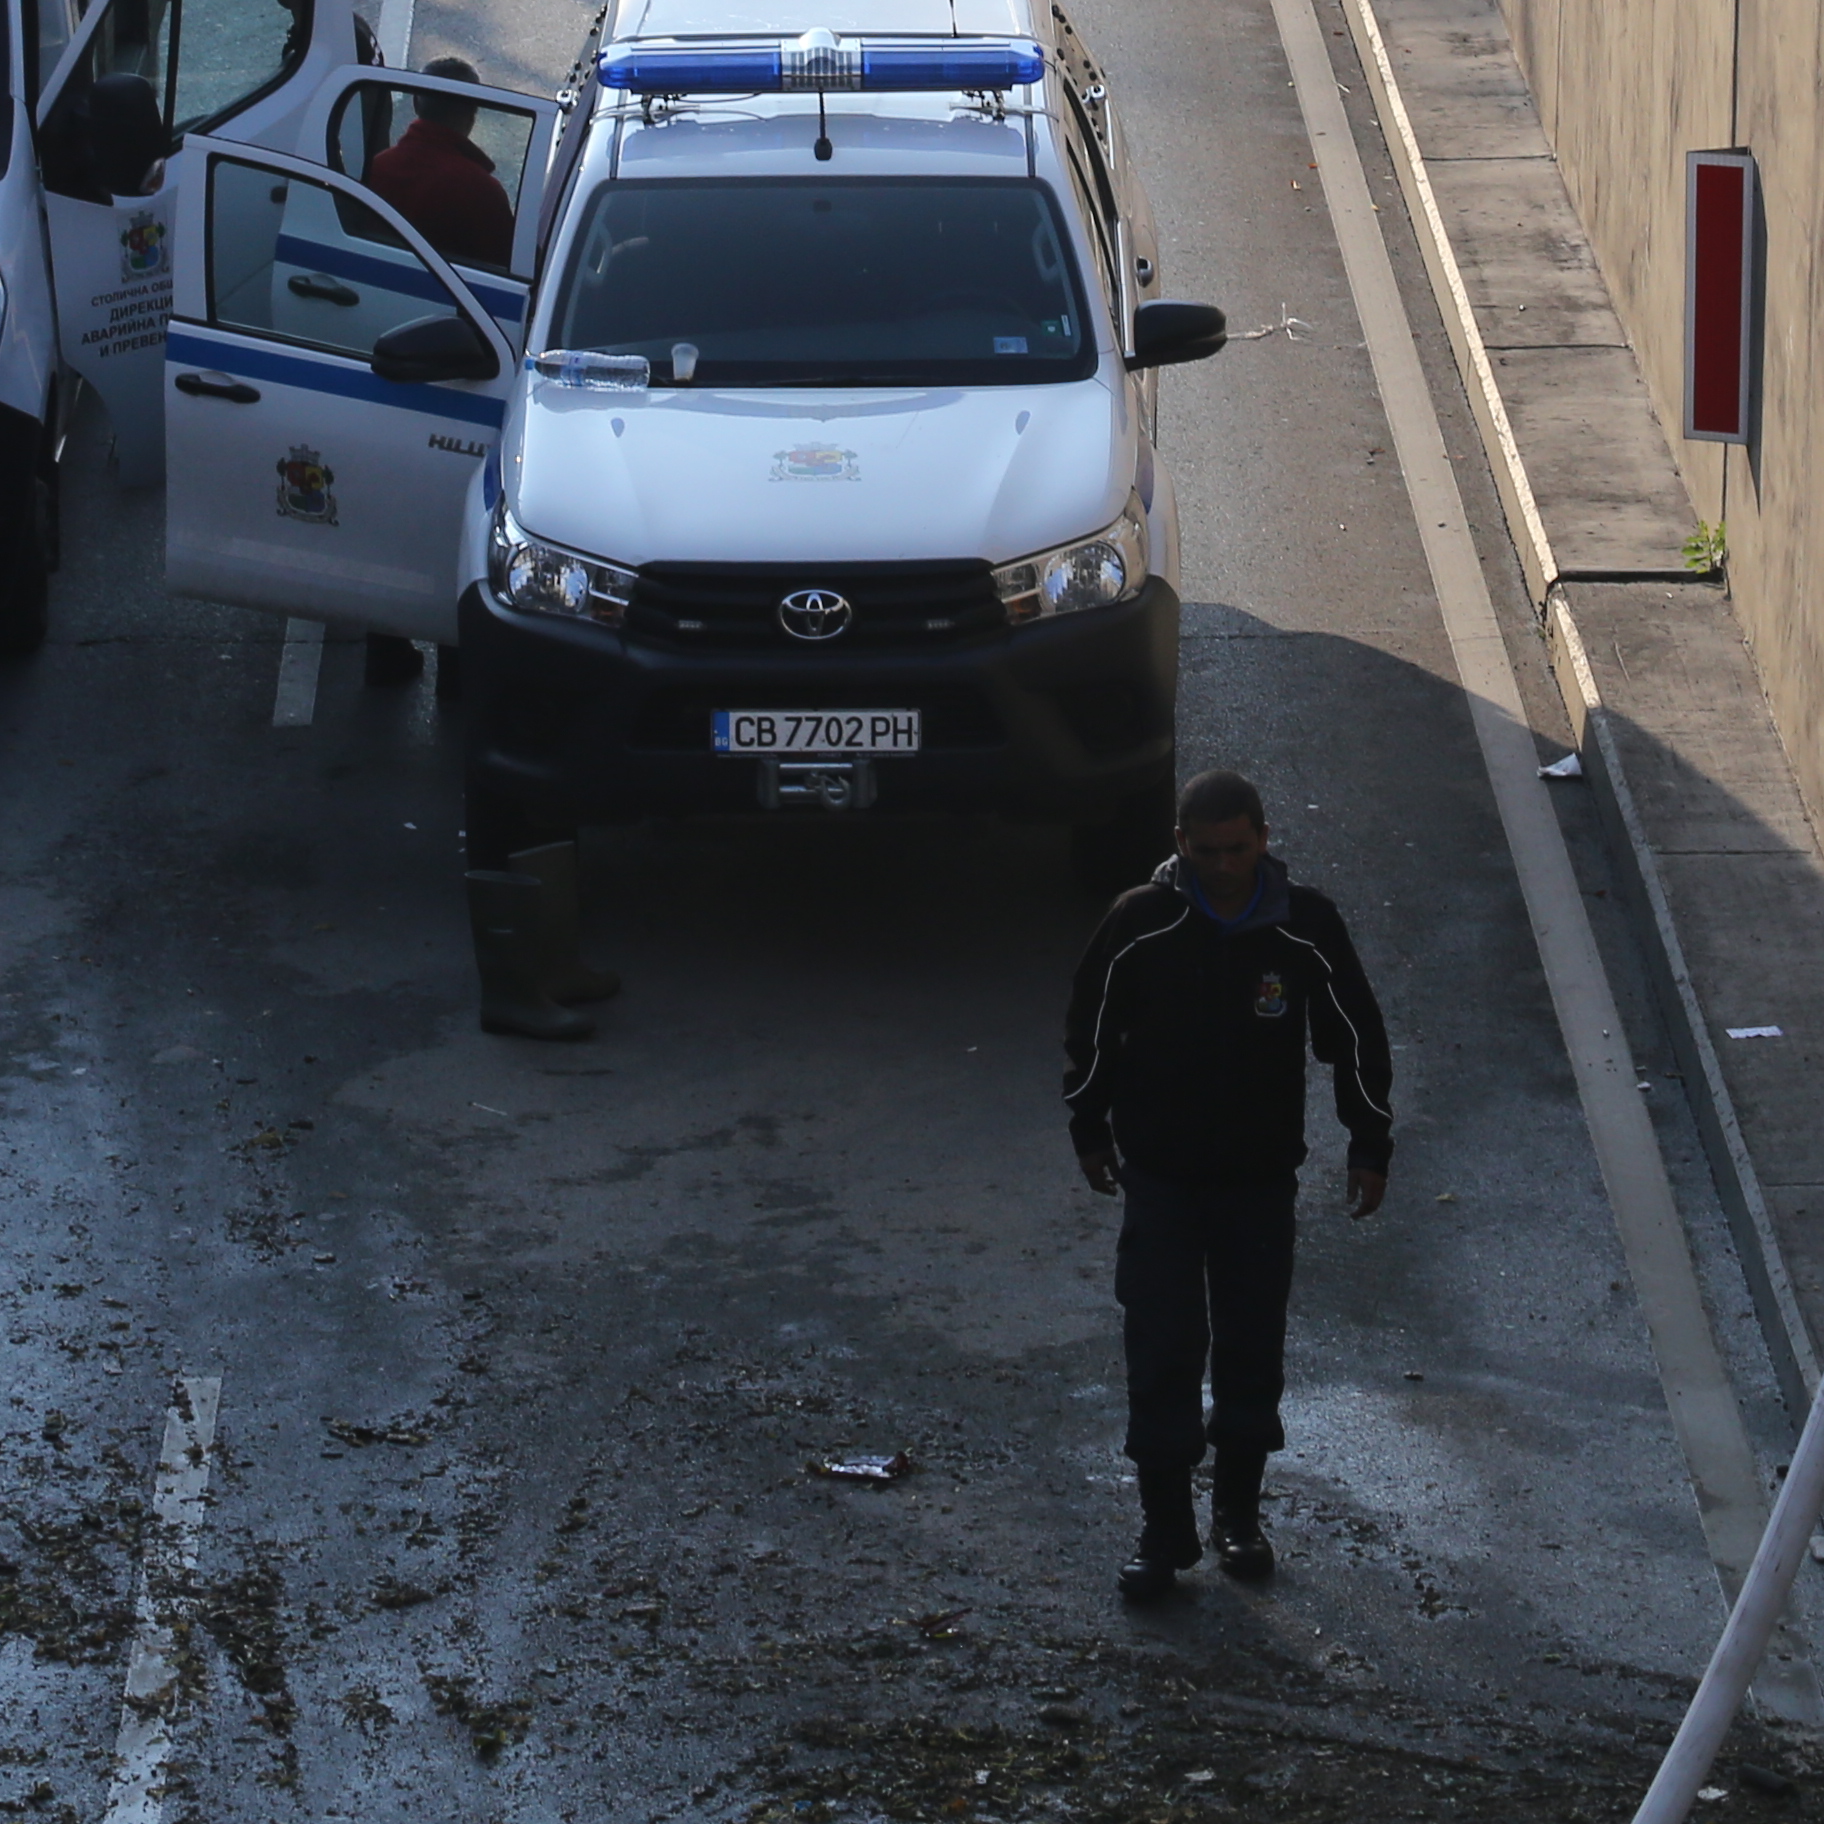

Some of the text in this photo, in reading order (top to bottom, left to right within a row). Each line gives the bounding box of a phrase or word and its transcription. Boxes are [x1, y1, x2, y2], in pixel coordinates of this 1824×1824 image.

[91, 285, 149, 307] СТОЛИЧНА
[110, 295, 173, 323] ДИРЕКЦИ
[81, 317, 156, 345] АВАРИЙНА
[99, 330, 167, 358] И ПРЕВЕН
[428, 433, 489, 458] HILU
[784, 716, 863, 747] 7702
